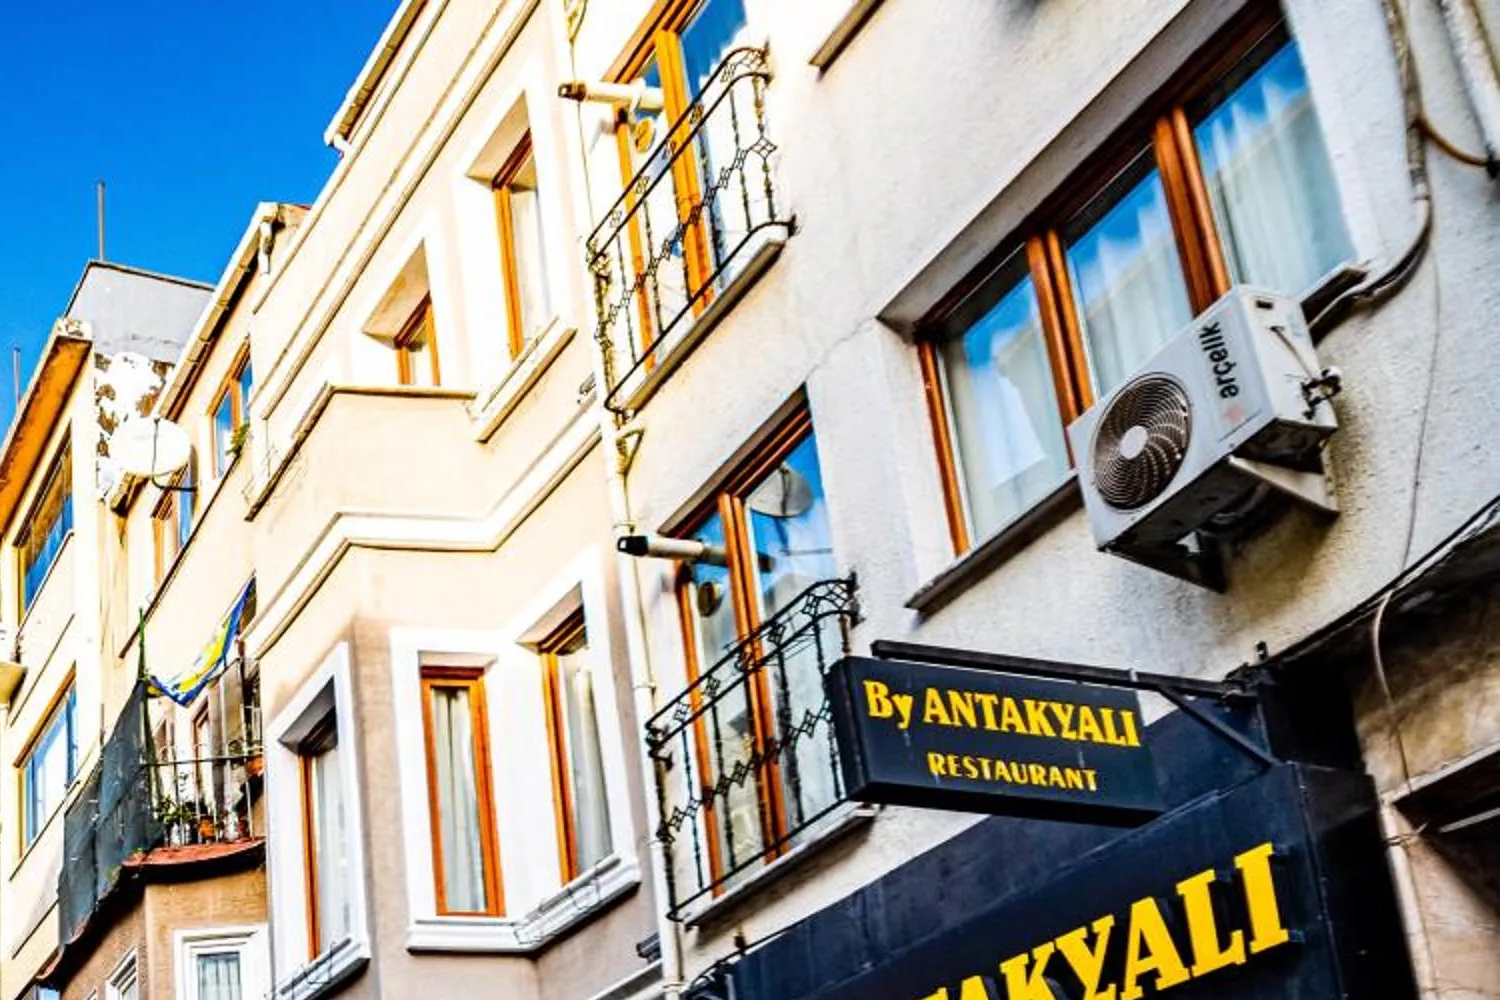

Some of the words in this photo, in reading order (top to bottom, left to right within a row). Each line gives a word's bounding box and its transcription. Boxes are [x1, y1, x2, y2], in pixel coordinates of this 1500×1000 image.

[862, 678, 913, 730] By
[923, 686, 1141, 748] ANTAKYALI
[926, 750, 1099, 793] RESTAURANT
